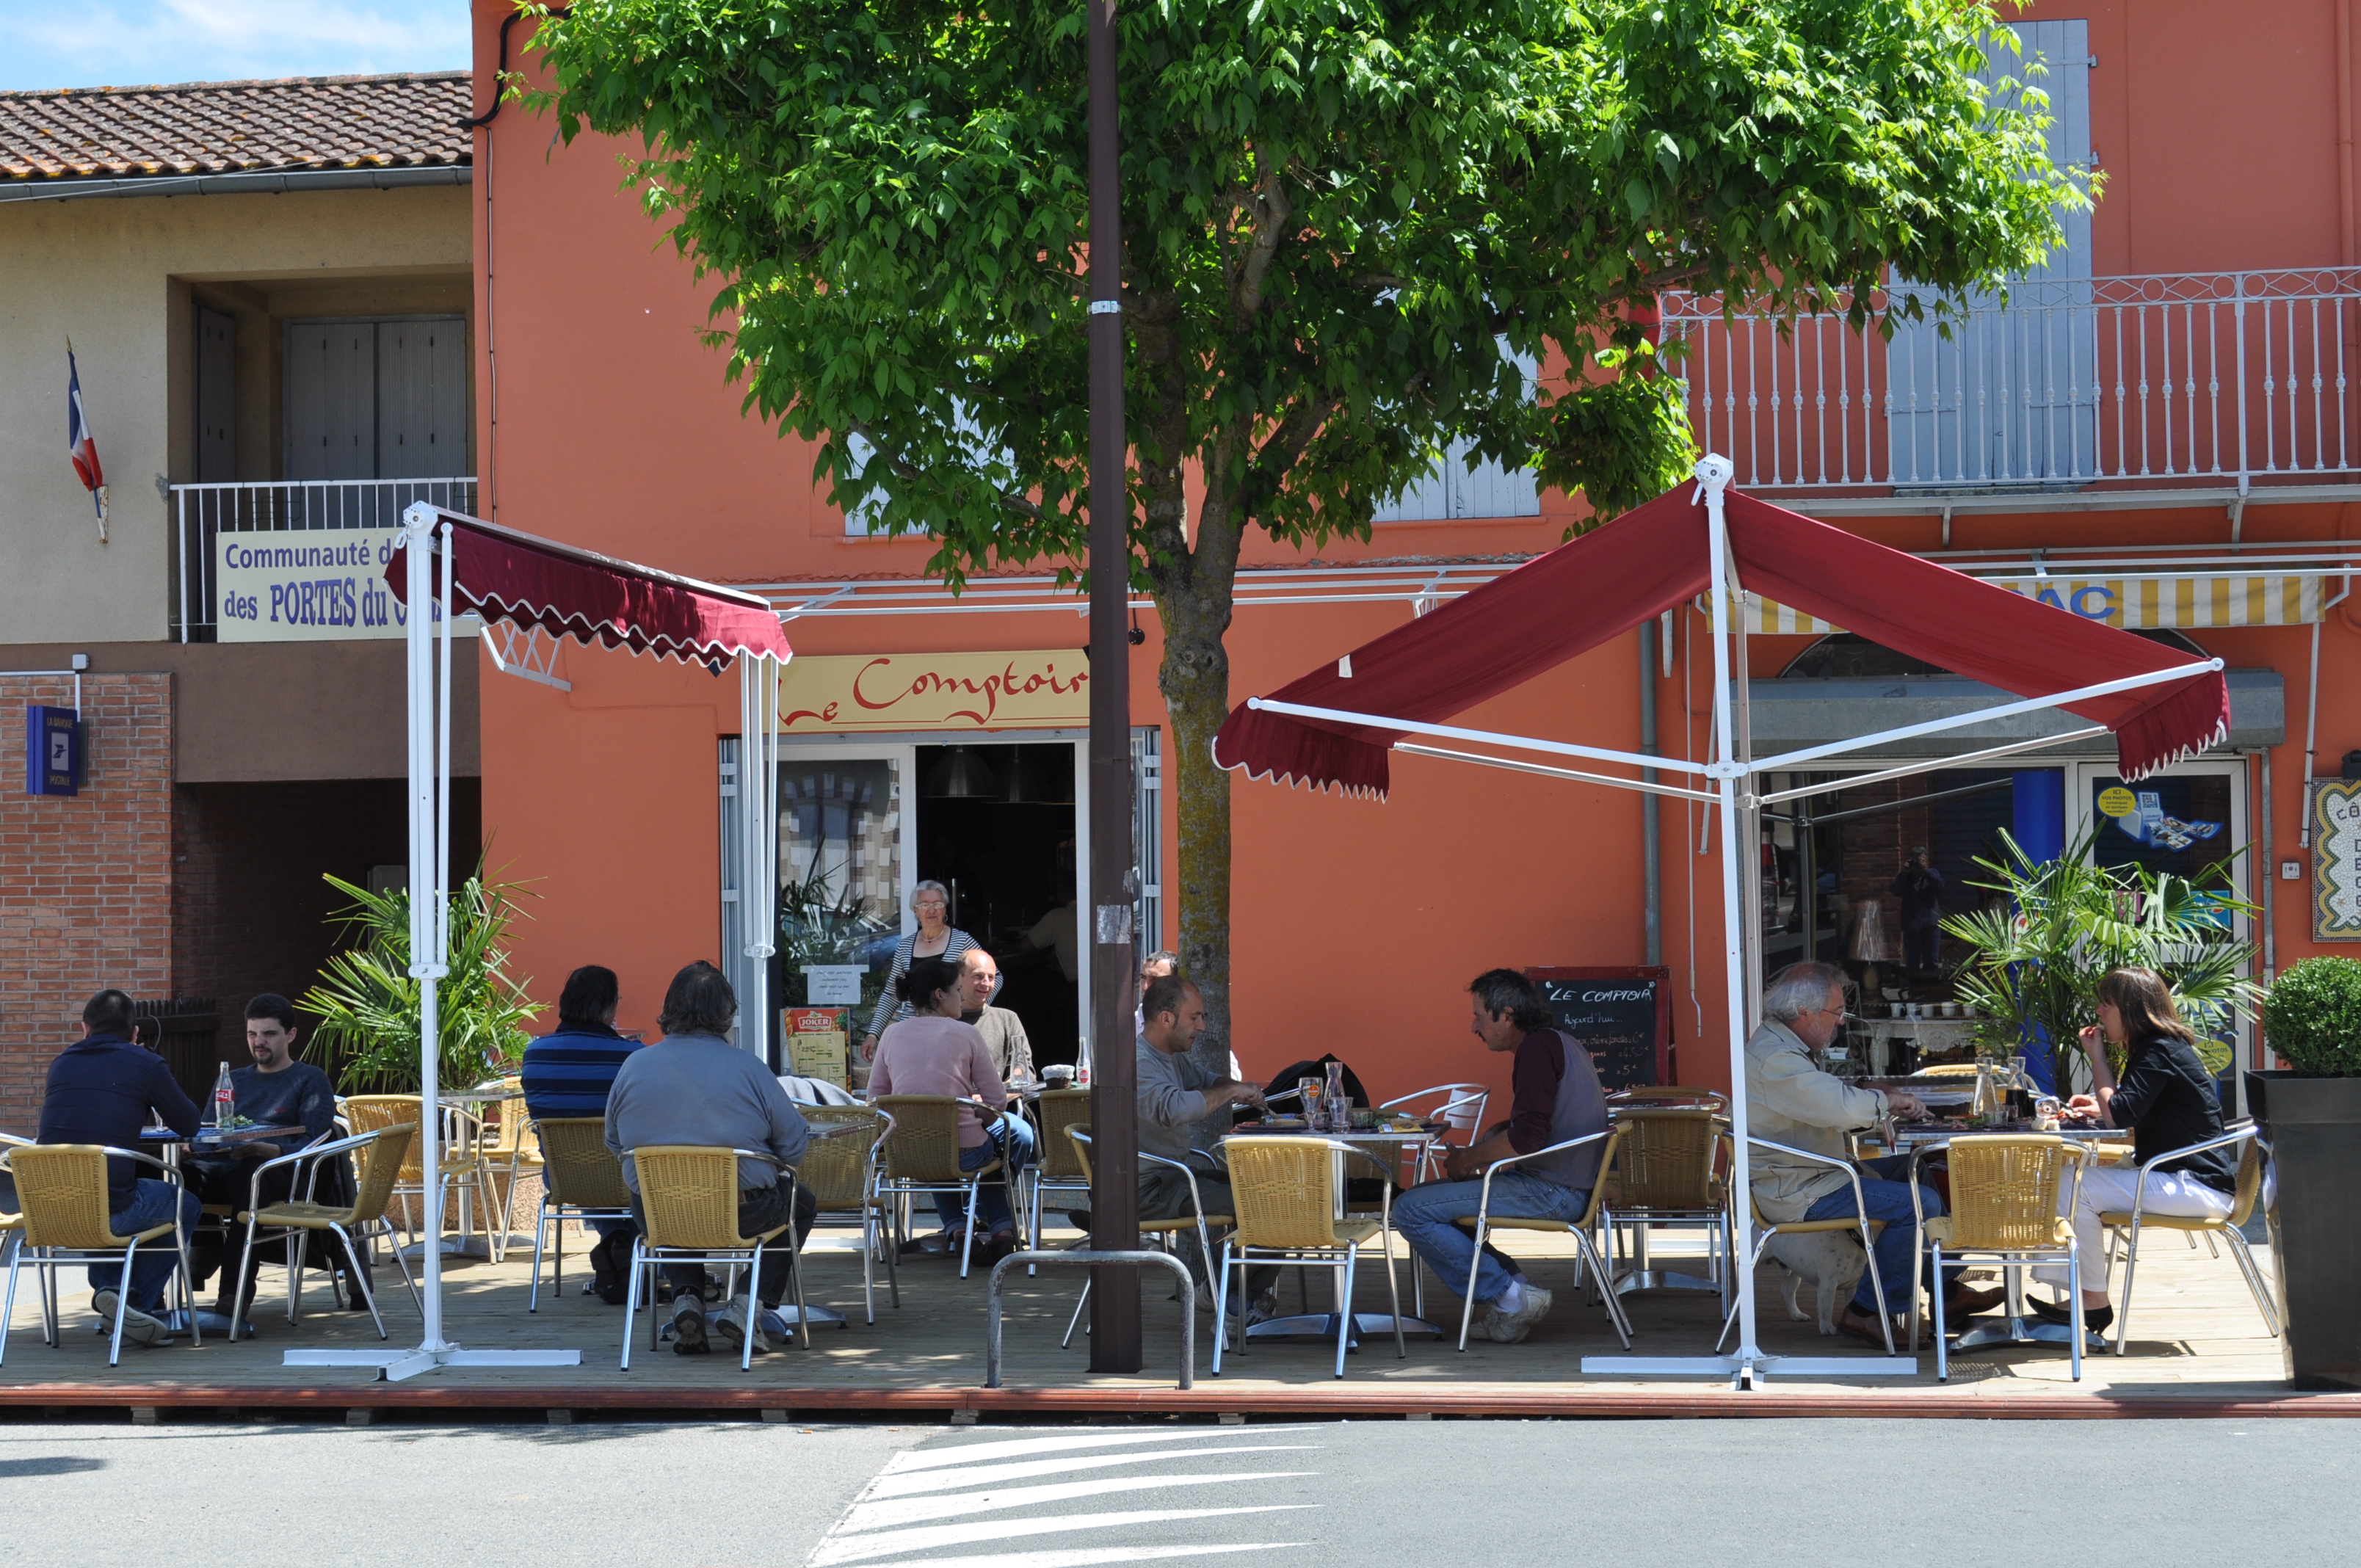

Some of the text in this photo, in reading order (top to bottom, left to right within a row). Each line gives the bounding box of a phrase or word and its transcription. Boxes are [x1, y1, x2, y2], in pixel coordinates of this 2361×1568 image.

[225, 538, 371, 568] Communauté
[224, 591, 258, 621] des
[270, 577, 357, 628] PORTES
[362, 578, 388, 627] du
[777, 658, 1089, 727] Le Comptoir
[47, 717, 73, 728] LA BANQUE
[49, 775, 70, 785] POSTALE
[801, 1018, 829, 1026] JOKER
